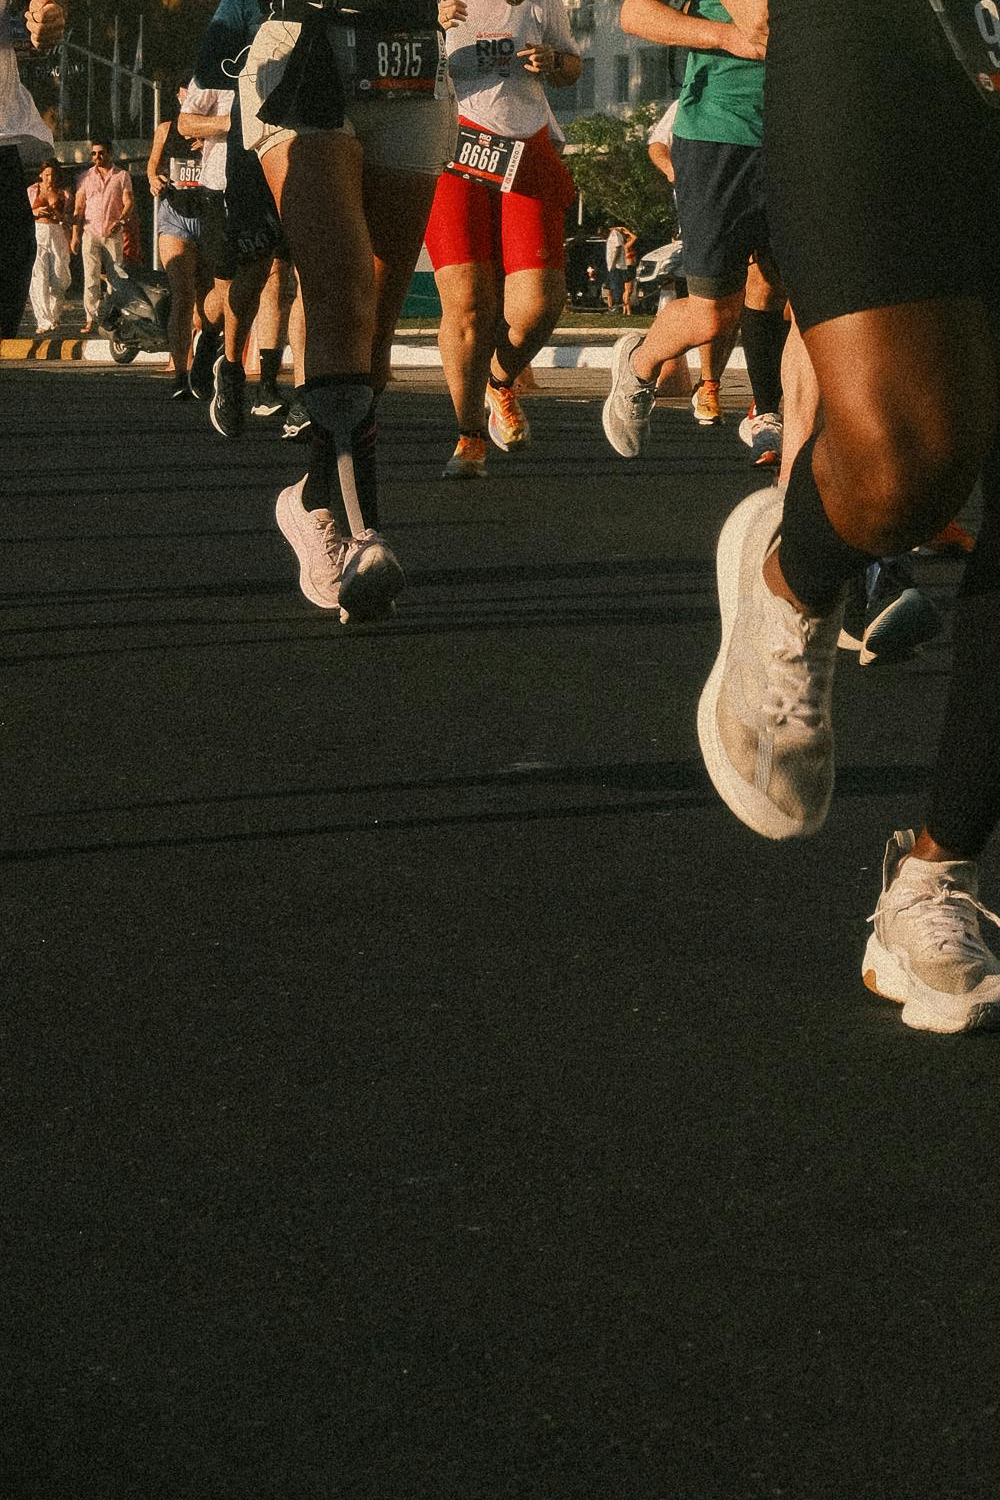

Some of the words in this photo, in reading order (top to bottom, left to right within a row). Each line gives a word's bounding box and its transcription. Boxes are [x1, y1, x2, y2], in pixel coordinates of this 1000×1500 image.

[476, 38, 515, 56] RIO
[377, 41, 422, 78] 8315
[459, 142, 500, 173] 8668
[180, 166, 201, 182] 8912
